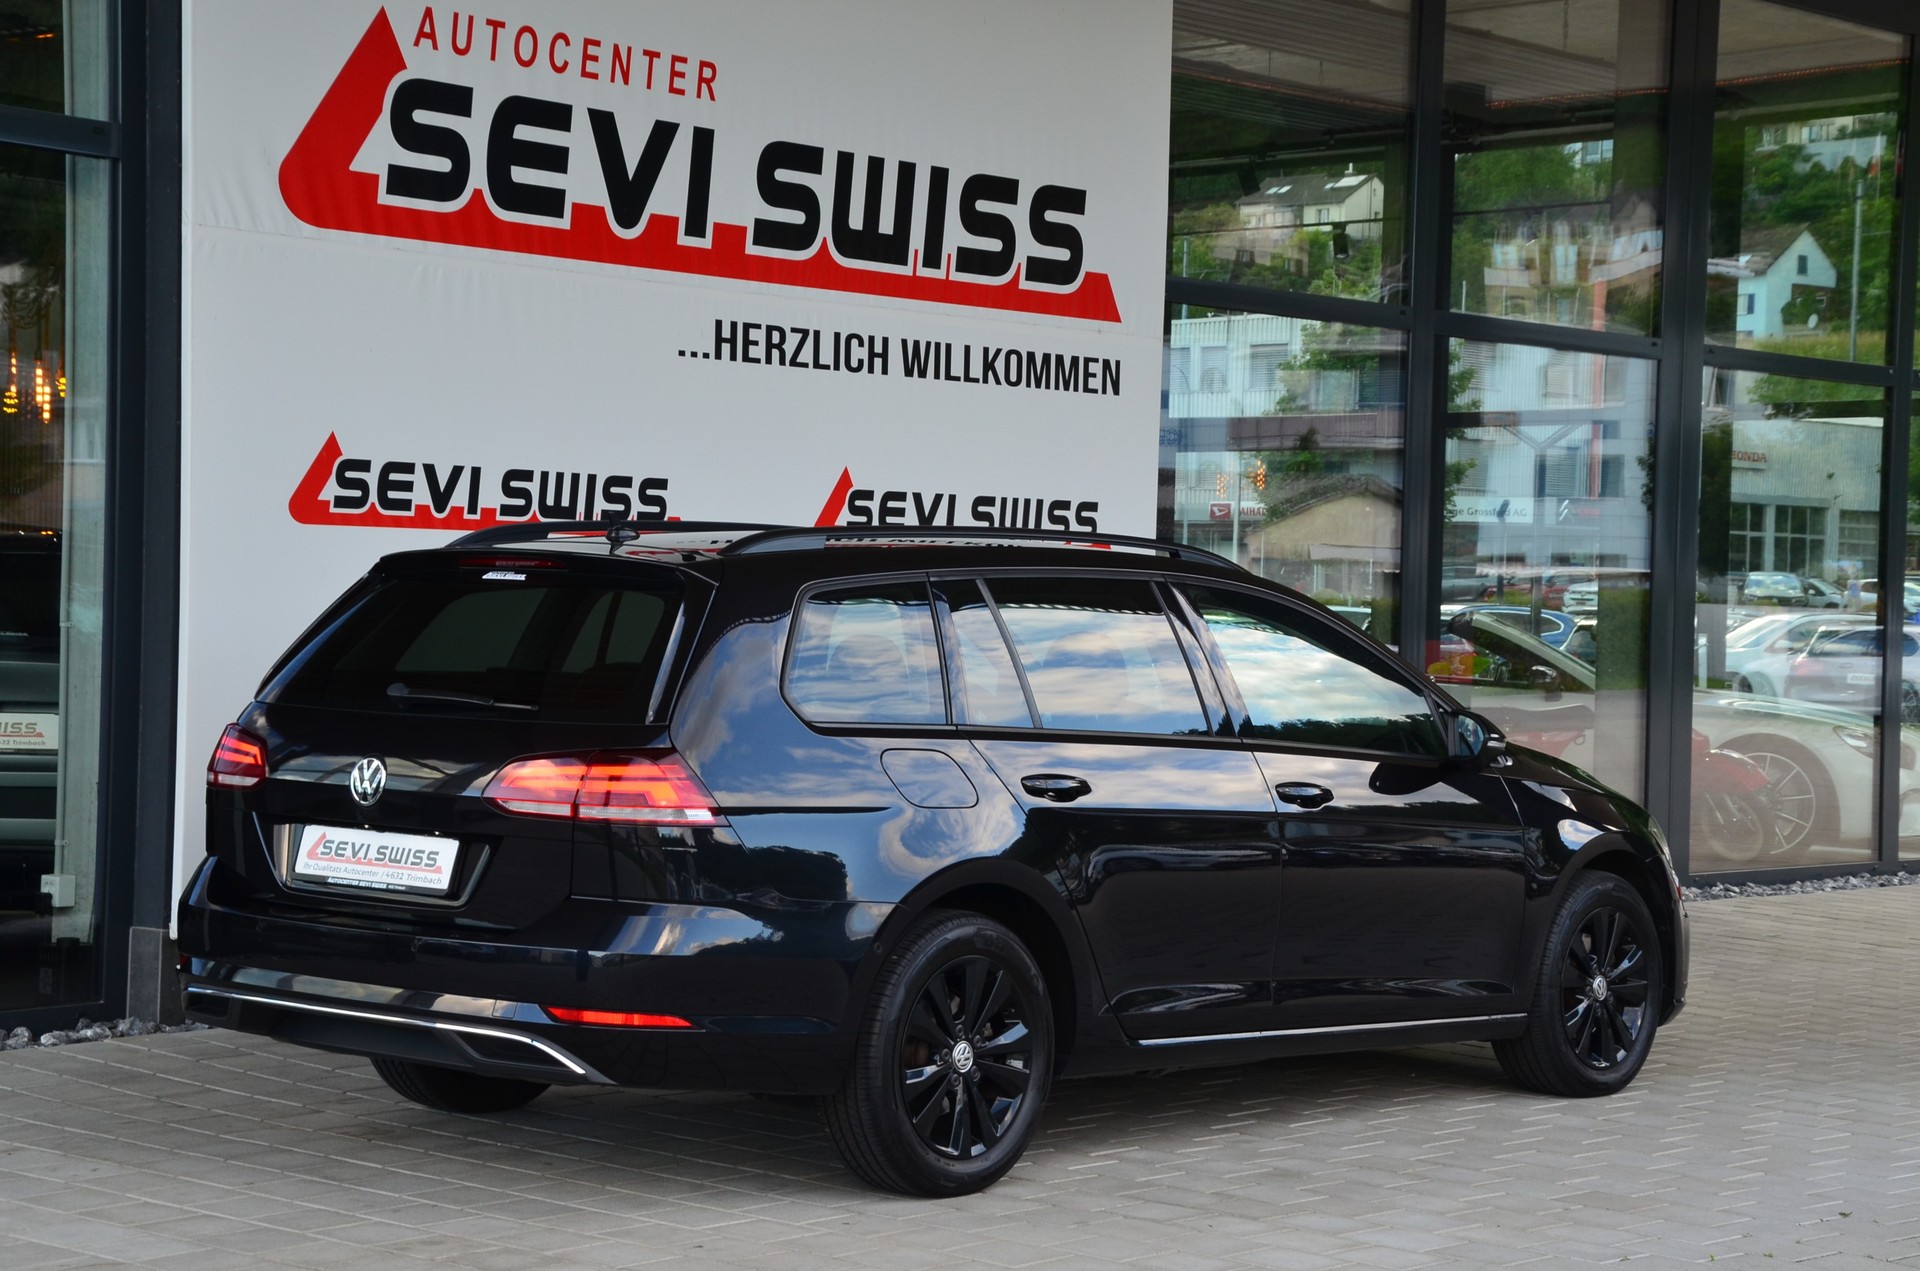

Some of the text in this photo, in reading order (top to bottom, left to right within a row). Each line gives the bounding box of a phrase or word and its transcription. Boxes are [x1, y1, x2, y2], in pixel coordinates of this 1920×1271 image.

[414, 7, 717, 101] AUTOCENTER
[385, 78, 1087, 286] SEVI SWISS
[900, 338, 1122, 397] WILLKOMMEN
[333, 458, 669, 521] SEVI SWISS
[846, 489, 1099, 534] SEVI SWISS
[303, 862, 312, 871] Ihr
[343, 867, 380, 878] Autocenter
[406, 873, 442, 886] Trimbach
[320, 839, 440, 868] SEVI SWISS
